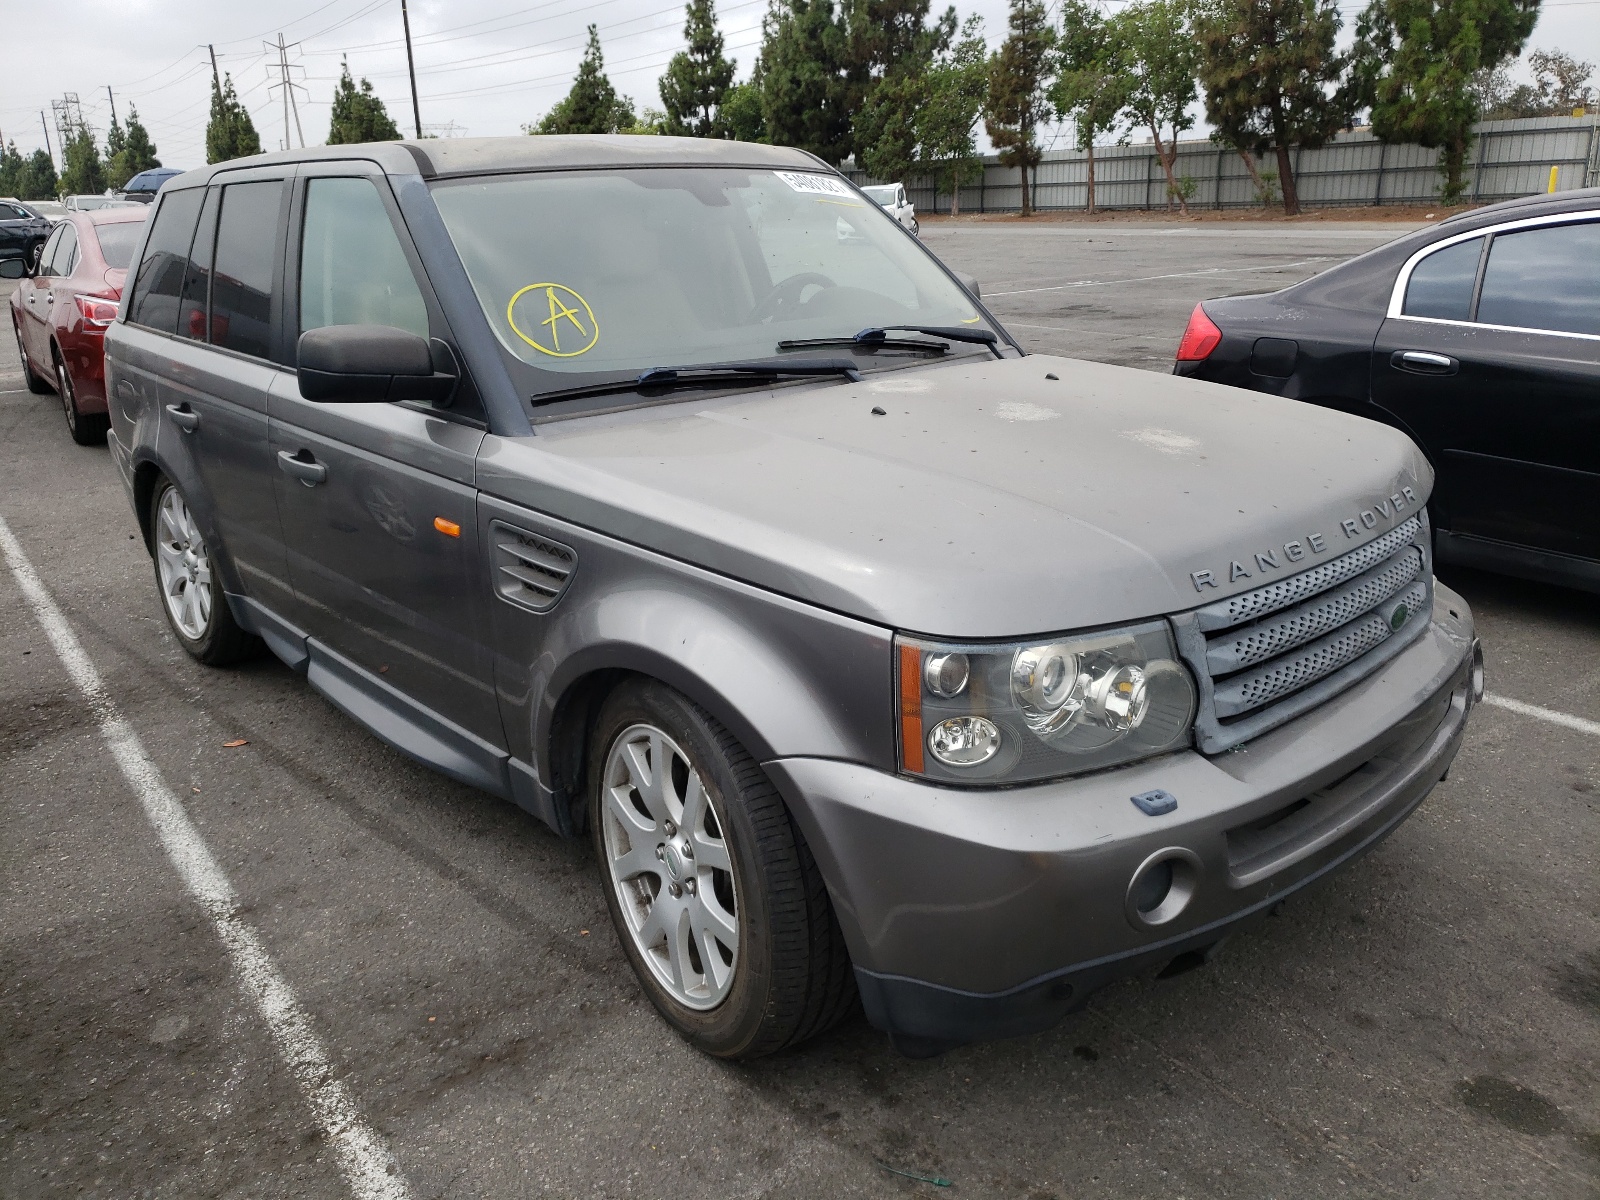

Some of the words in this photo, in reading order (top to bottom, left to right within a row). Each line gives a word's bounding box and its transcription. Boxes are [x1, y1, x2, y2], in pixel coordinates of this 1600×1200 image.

[541, 286, 587, 351] A
[1190, 532, 1328, 592] RANGE
[1340, 485, 1417, 539] ROVER
